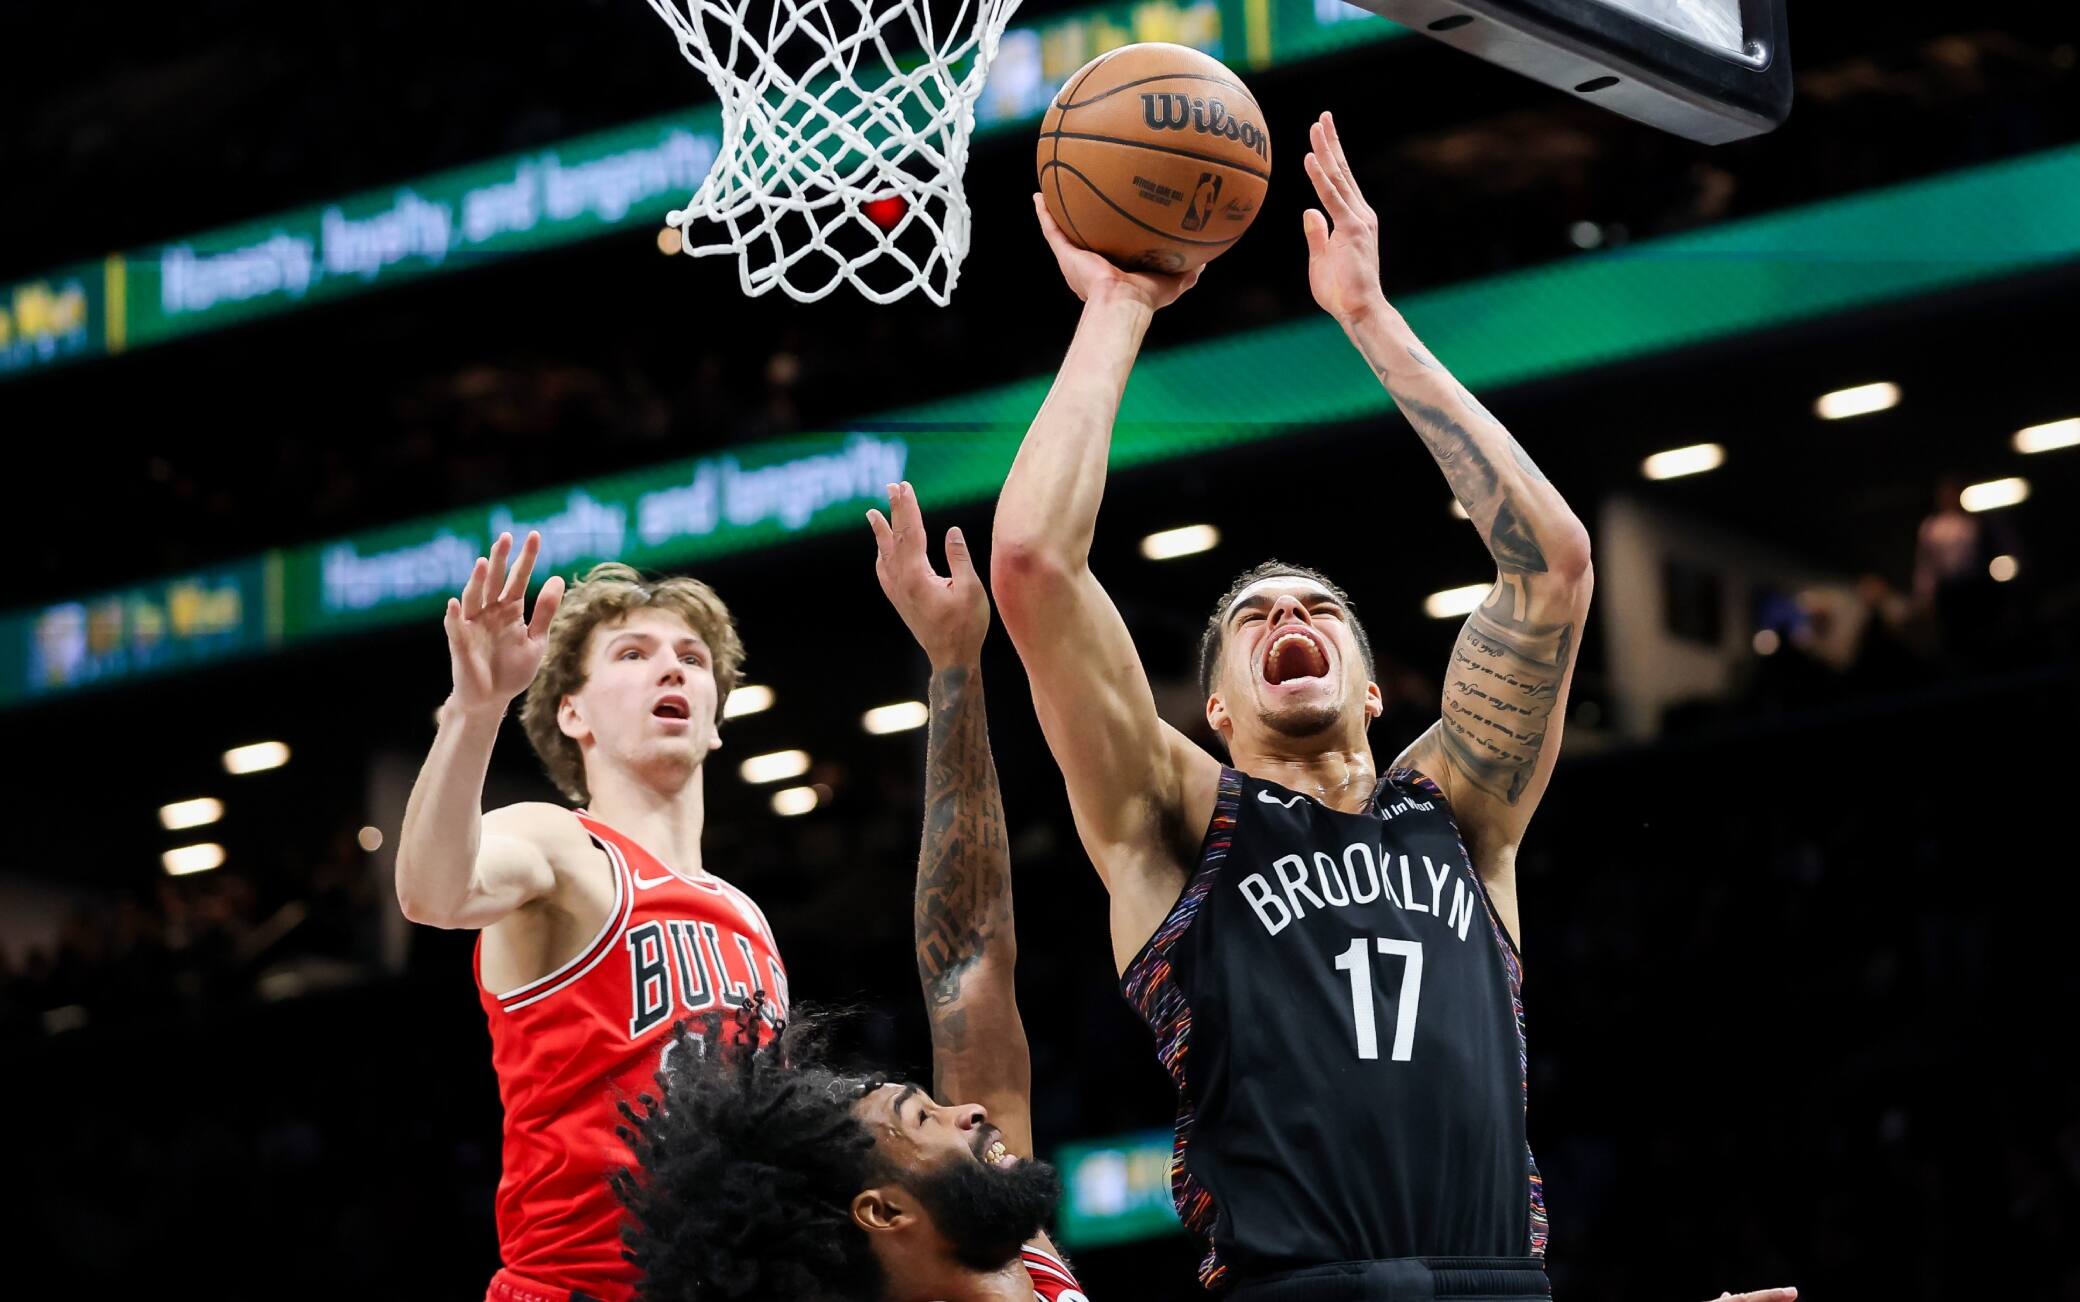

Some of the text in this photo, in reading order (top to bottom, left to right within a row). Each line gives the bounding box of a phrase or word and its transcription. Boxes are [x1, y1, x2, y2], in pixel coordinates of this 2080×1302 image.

[1140, 92, 1268, 162] Wilson
[462, 156, 539, 243] and
[637, 456, 722, 546] and
[1381, 808, 1393, 820] ll
[1390, 802, 1408, 816] In
[1238, 842, 1474, 942] BROOKLYN
[1334, 937, 1424, 1062] 17
